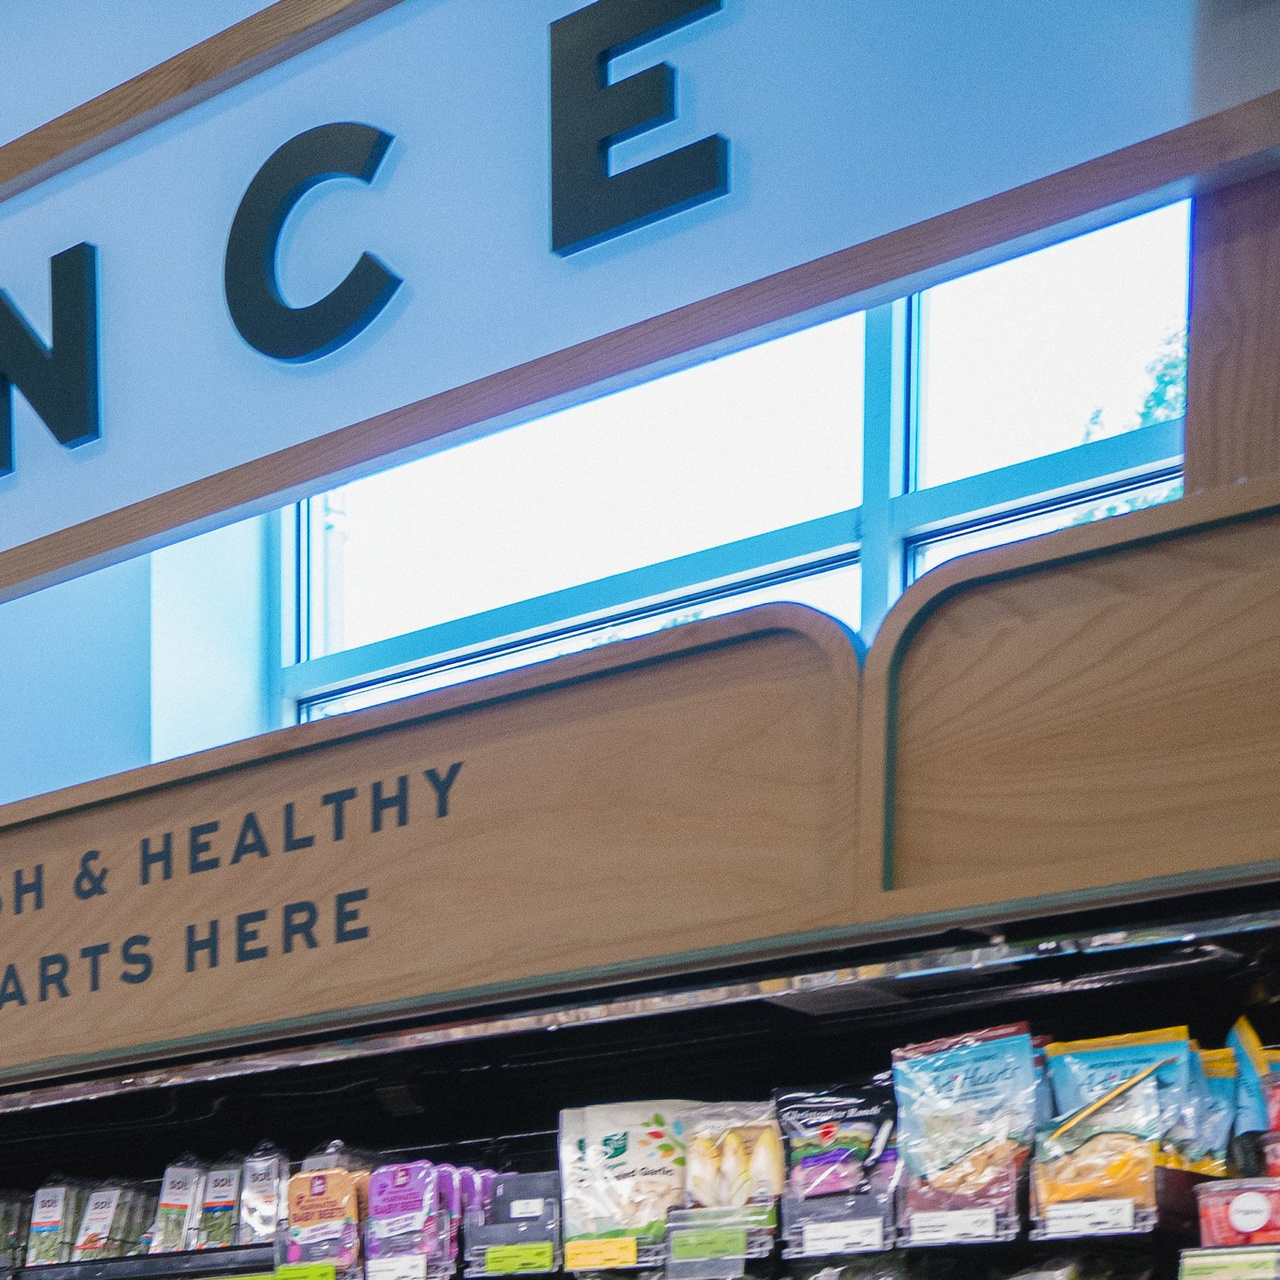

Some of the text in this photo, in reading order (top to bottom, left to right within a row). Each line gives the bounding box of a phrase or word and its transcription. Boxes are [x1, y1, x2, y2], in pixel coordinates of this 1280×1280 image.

[73, 850, 110, 900] &
[139, 760, 466, 886] HEALTHY
[186, 887, 370, 974] HERE
